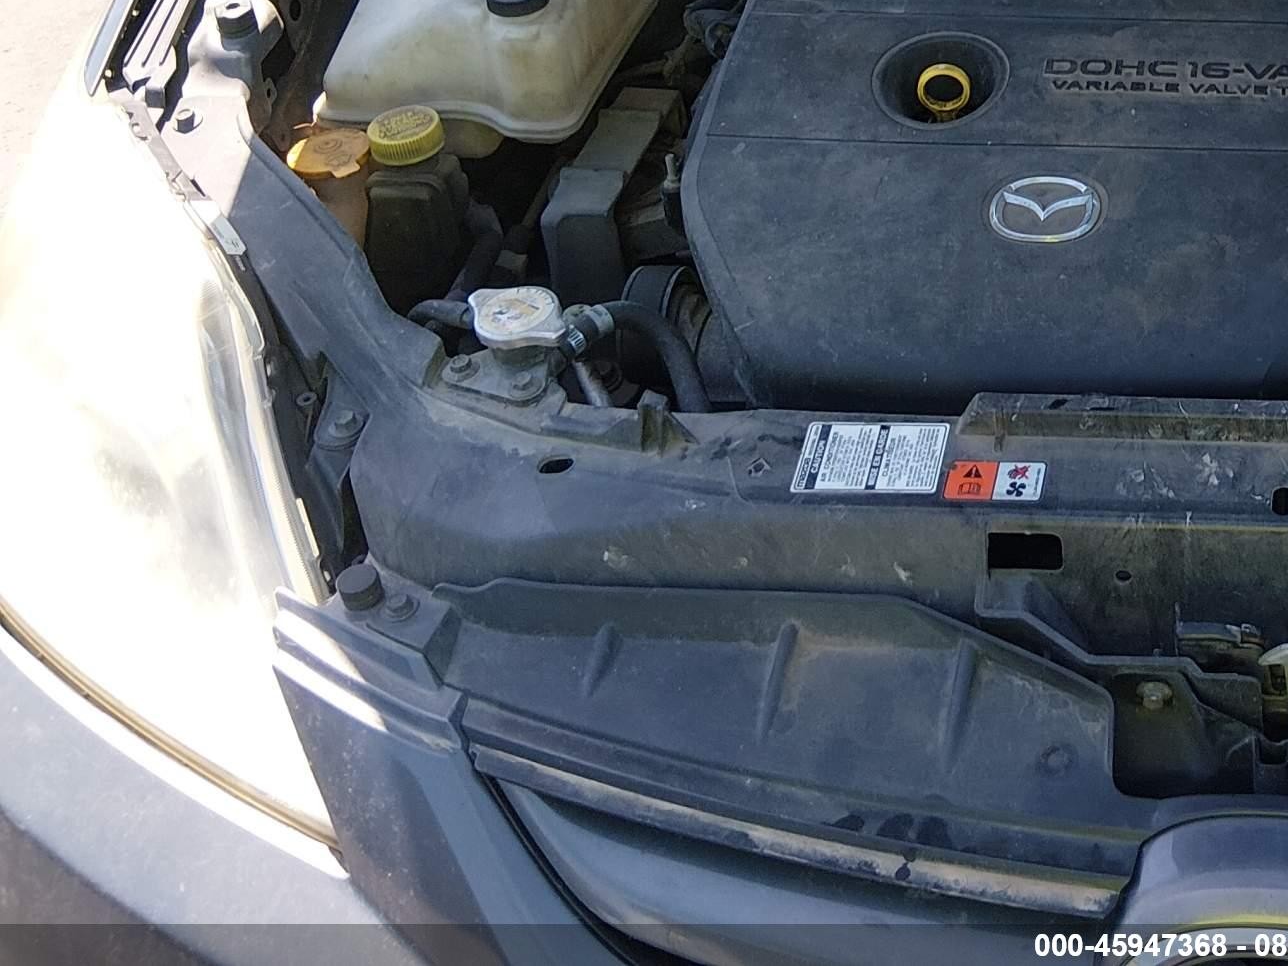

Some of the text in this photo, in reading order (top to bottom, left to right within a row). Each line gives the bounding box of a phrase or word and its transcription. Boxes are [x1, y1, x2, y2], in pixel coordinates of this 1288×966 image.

[1044, 57, 1178, 78] DOHC
[1050, 79, 1181, 94] VARIABLE
[1189, 83, 1269, 96] VALVE
[810, 440, 826, 473] CAUTION
